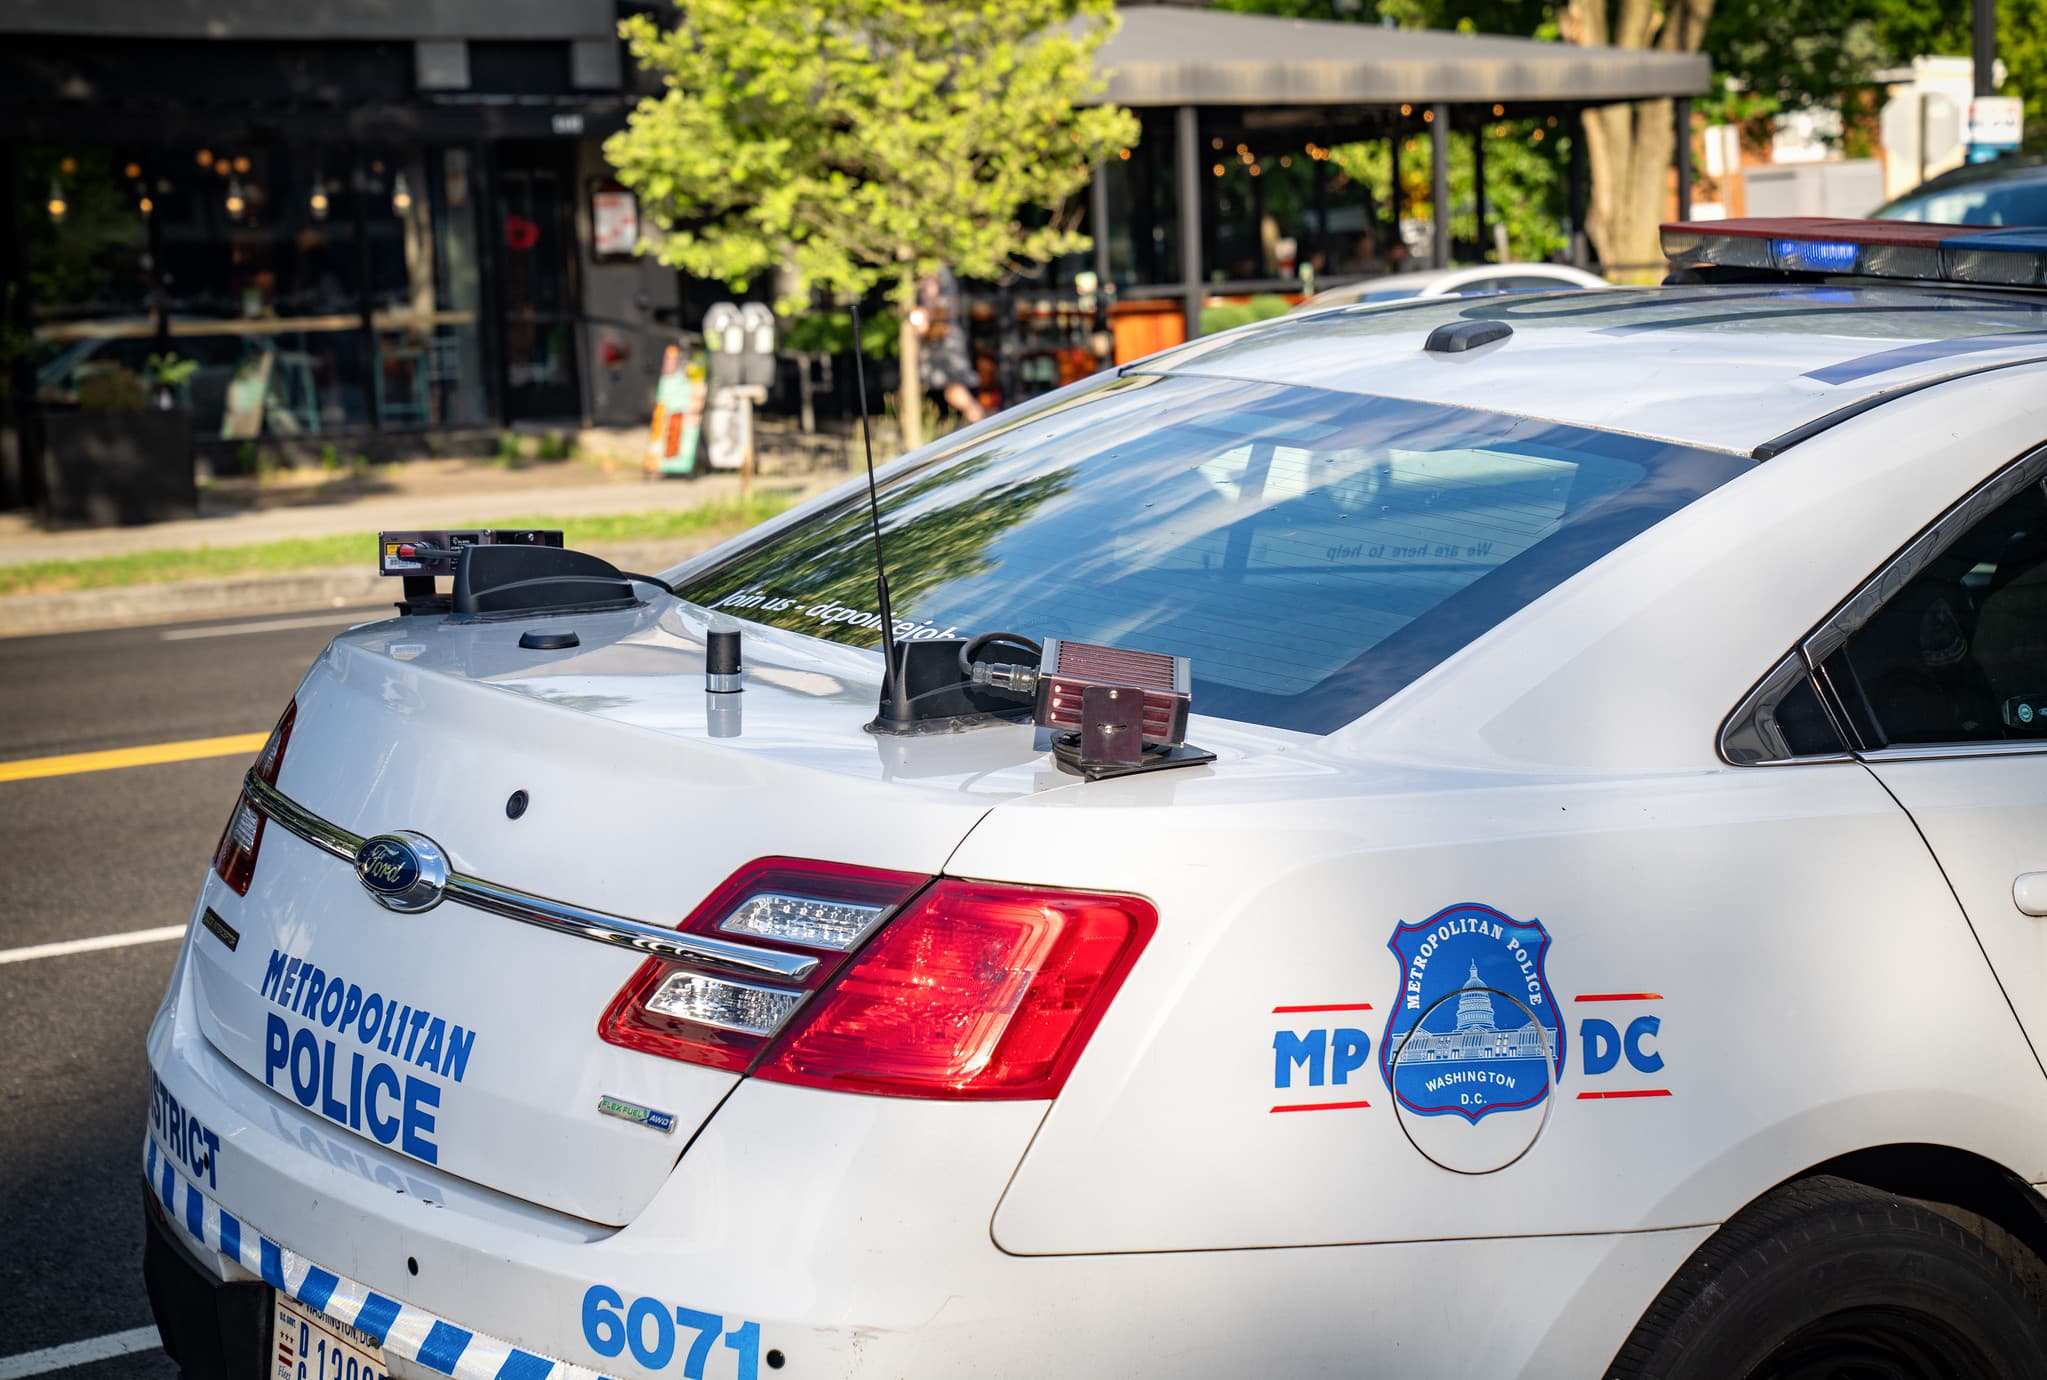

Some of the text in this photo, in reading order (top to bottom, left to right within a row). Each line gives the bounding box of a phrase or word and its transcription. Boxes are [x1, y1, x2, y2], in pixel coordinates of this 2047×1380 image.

[760, 598, 797, 611] us
[364, 844, 406, 883] Ford
[1407, 918, 1542, 1009] METROPOLITAN POLICE
[260, 949, 476, 1083] METROPOLITAN
[1579, 1015, 1664, 1076] DC
[265, 1011, 441, 1165] POLICE
[1273, 1028, 1371, 1088] MP
[1425, 1071, 1516, 1092] WASHINGTON
[602, 1100, 669, 1126] FLEX FUEL AWD
[1461, 1093, 1487, 1105] D.C.
[151, 1070, 220, 1191] STRICT
[581, 1284, 761, 1380] 6071
